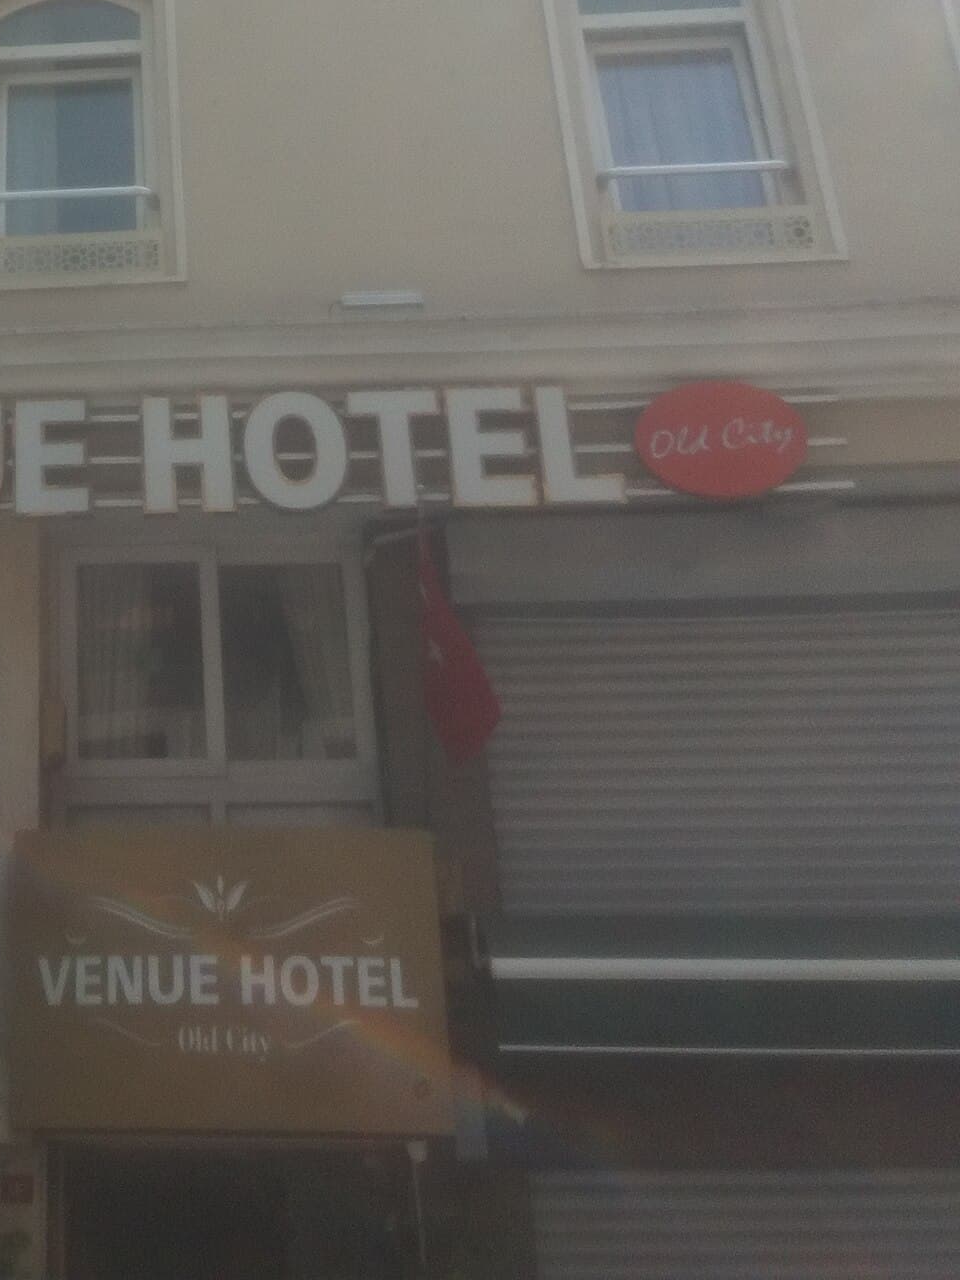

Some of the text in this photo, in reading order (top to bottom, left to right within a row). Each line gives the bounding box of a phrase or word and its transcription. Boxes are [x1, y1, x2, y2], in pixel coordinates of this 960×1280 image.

[141, 384, 628, 514] HOTEL
[649, 418, 797, 460] Old City
[39, 954, 420, 1009] VENUE HOTEL
[178, 1026, 219, 1053] Old
